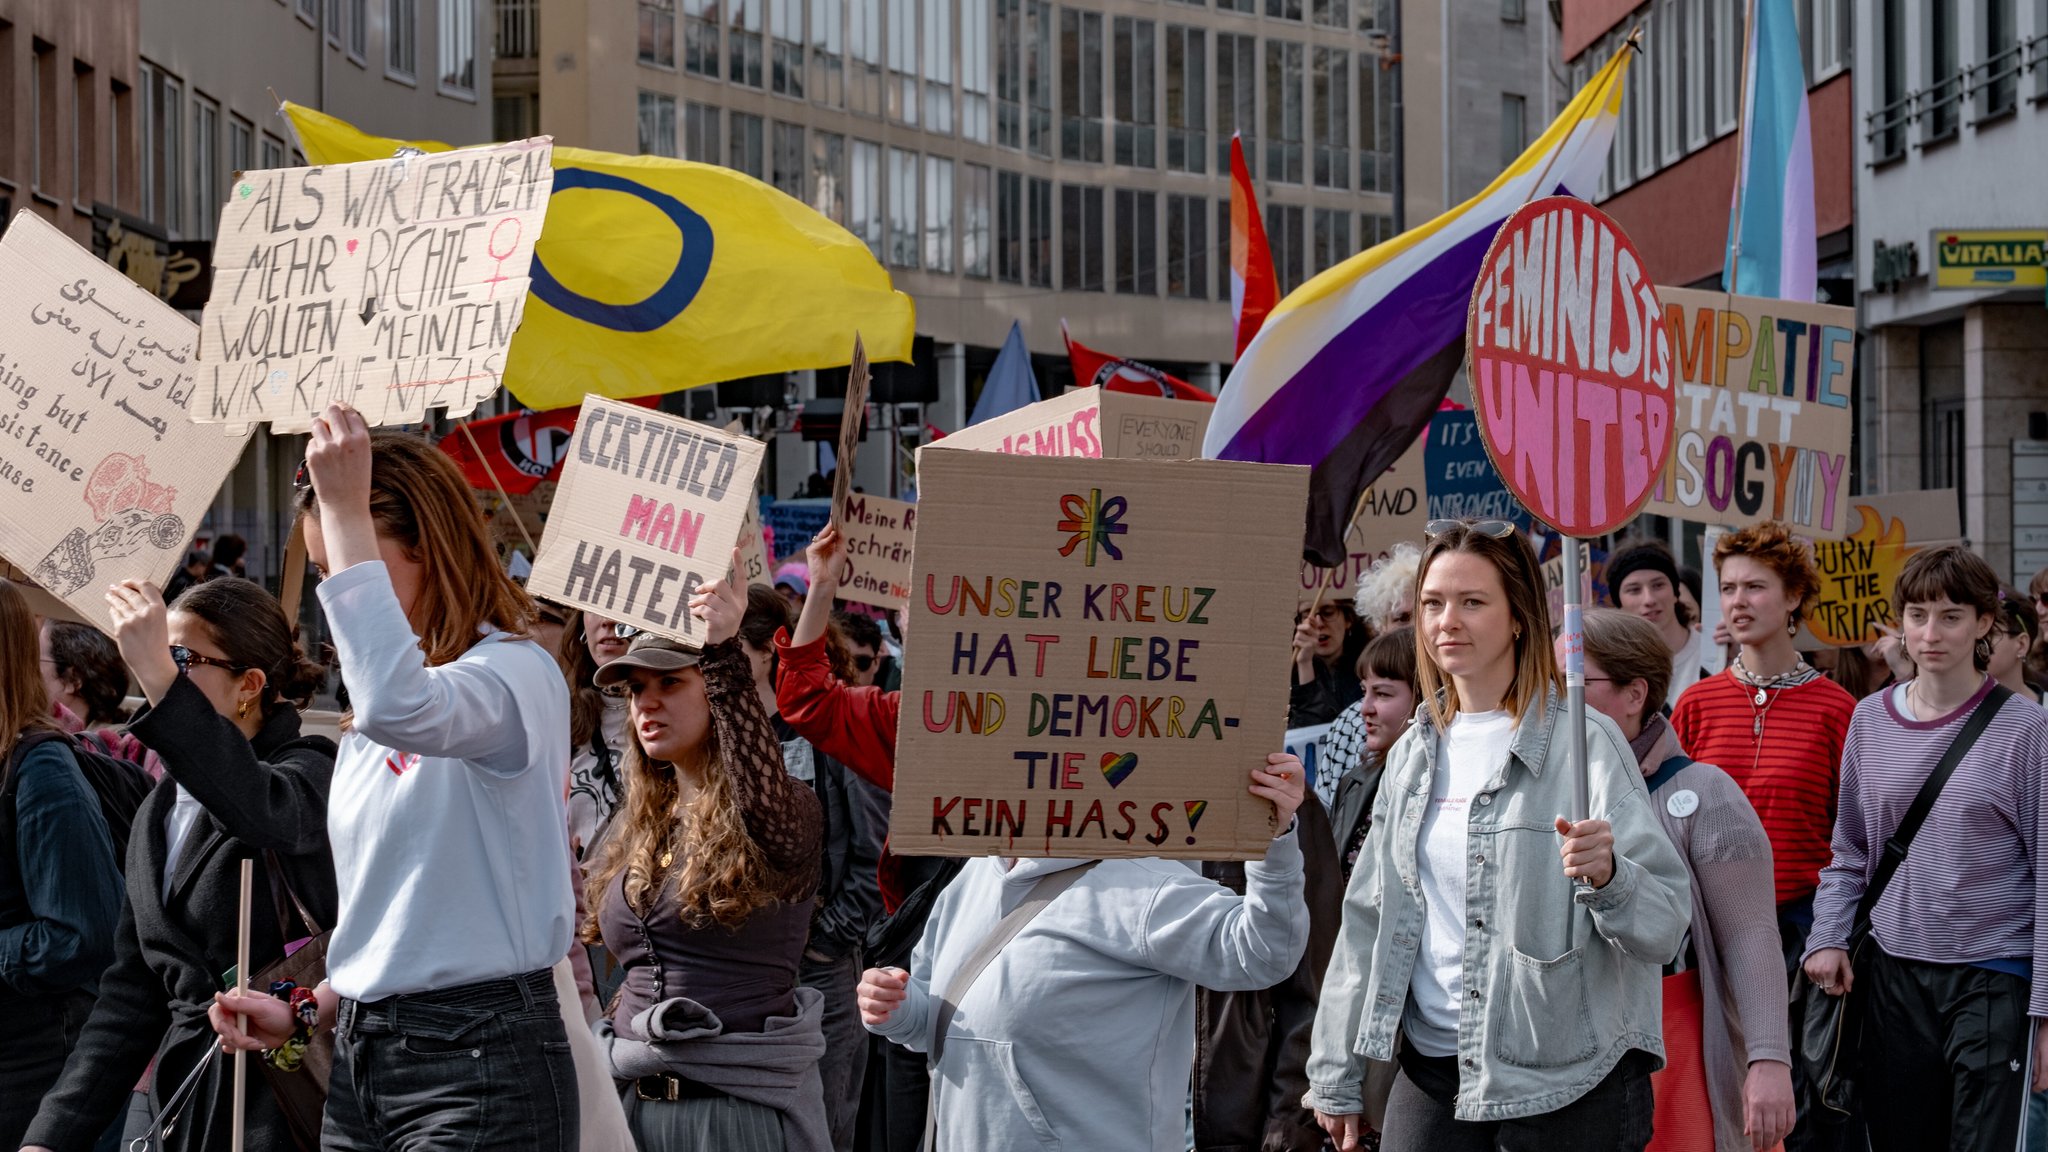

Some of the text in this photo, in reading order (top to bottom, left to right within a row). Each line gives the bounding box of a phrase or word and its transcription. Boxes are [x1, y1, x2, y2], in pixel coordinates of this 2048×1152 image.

[238, 149, 544, 233] ALS WIR FRAUEN
[233, 222, 487, 312] MEHR RECHTE
[1942, 244, 2042, 264] VITALIA
[1477, 207, 1670, 390] FEMINISTS
[219, 297, 518, 362] WOLLTEN MEINTEN
[1660, 302, 1853, 409] MPATIE
[212, 356, 270, 419] WIR
[384, 353, 501, 422] NAZIS
[46, 394, 89, 434] but
[1123, 418, 1193, 441] EVERYONE
[0, 413, 84, 481] sistance
[579, 407, 738, 502] CERTIFIED
[1135, 441, 1180, 456] SHOULD
[1480, 358, 1669, 527] UNITED
[0, 457, 34, 493] nse
[1445, 460, 1487, 480] EVEN
[620, 493, 705, 558] MAN
[845, 495, 897, 529] Meine
[1428, 489, 1523, 521] INTROVERTS
[563, 540, 705, 636] HATER
[839, 556, 889, 595] Deine
[925, 573, 1216, 624] UNSER KREUZ
[1831, 573, 1881, 601] THE
[952, 632, 1200, 682] HAT LIEBE
[923, 690, 1240, 740] UND DEMOKRA-
[1013, 751, 1086, 790] TIE
[931, 796, 1208, 848] KEIN HASS!
